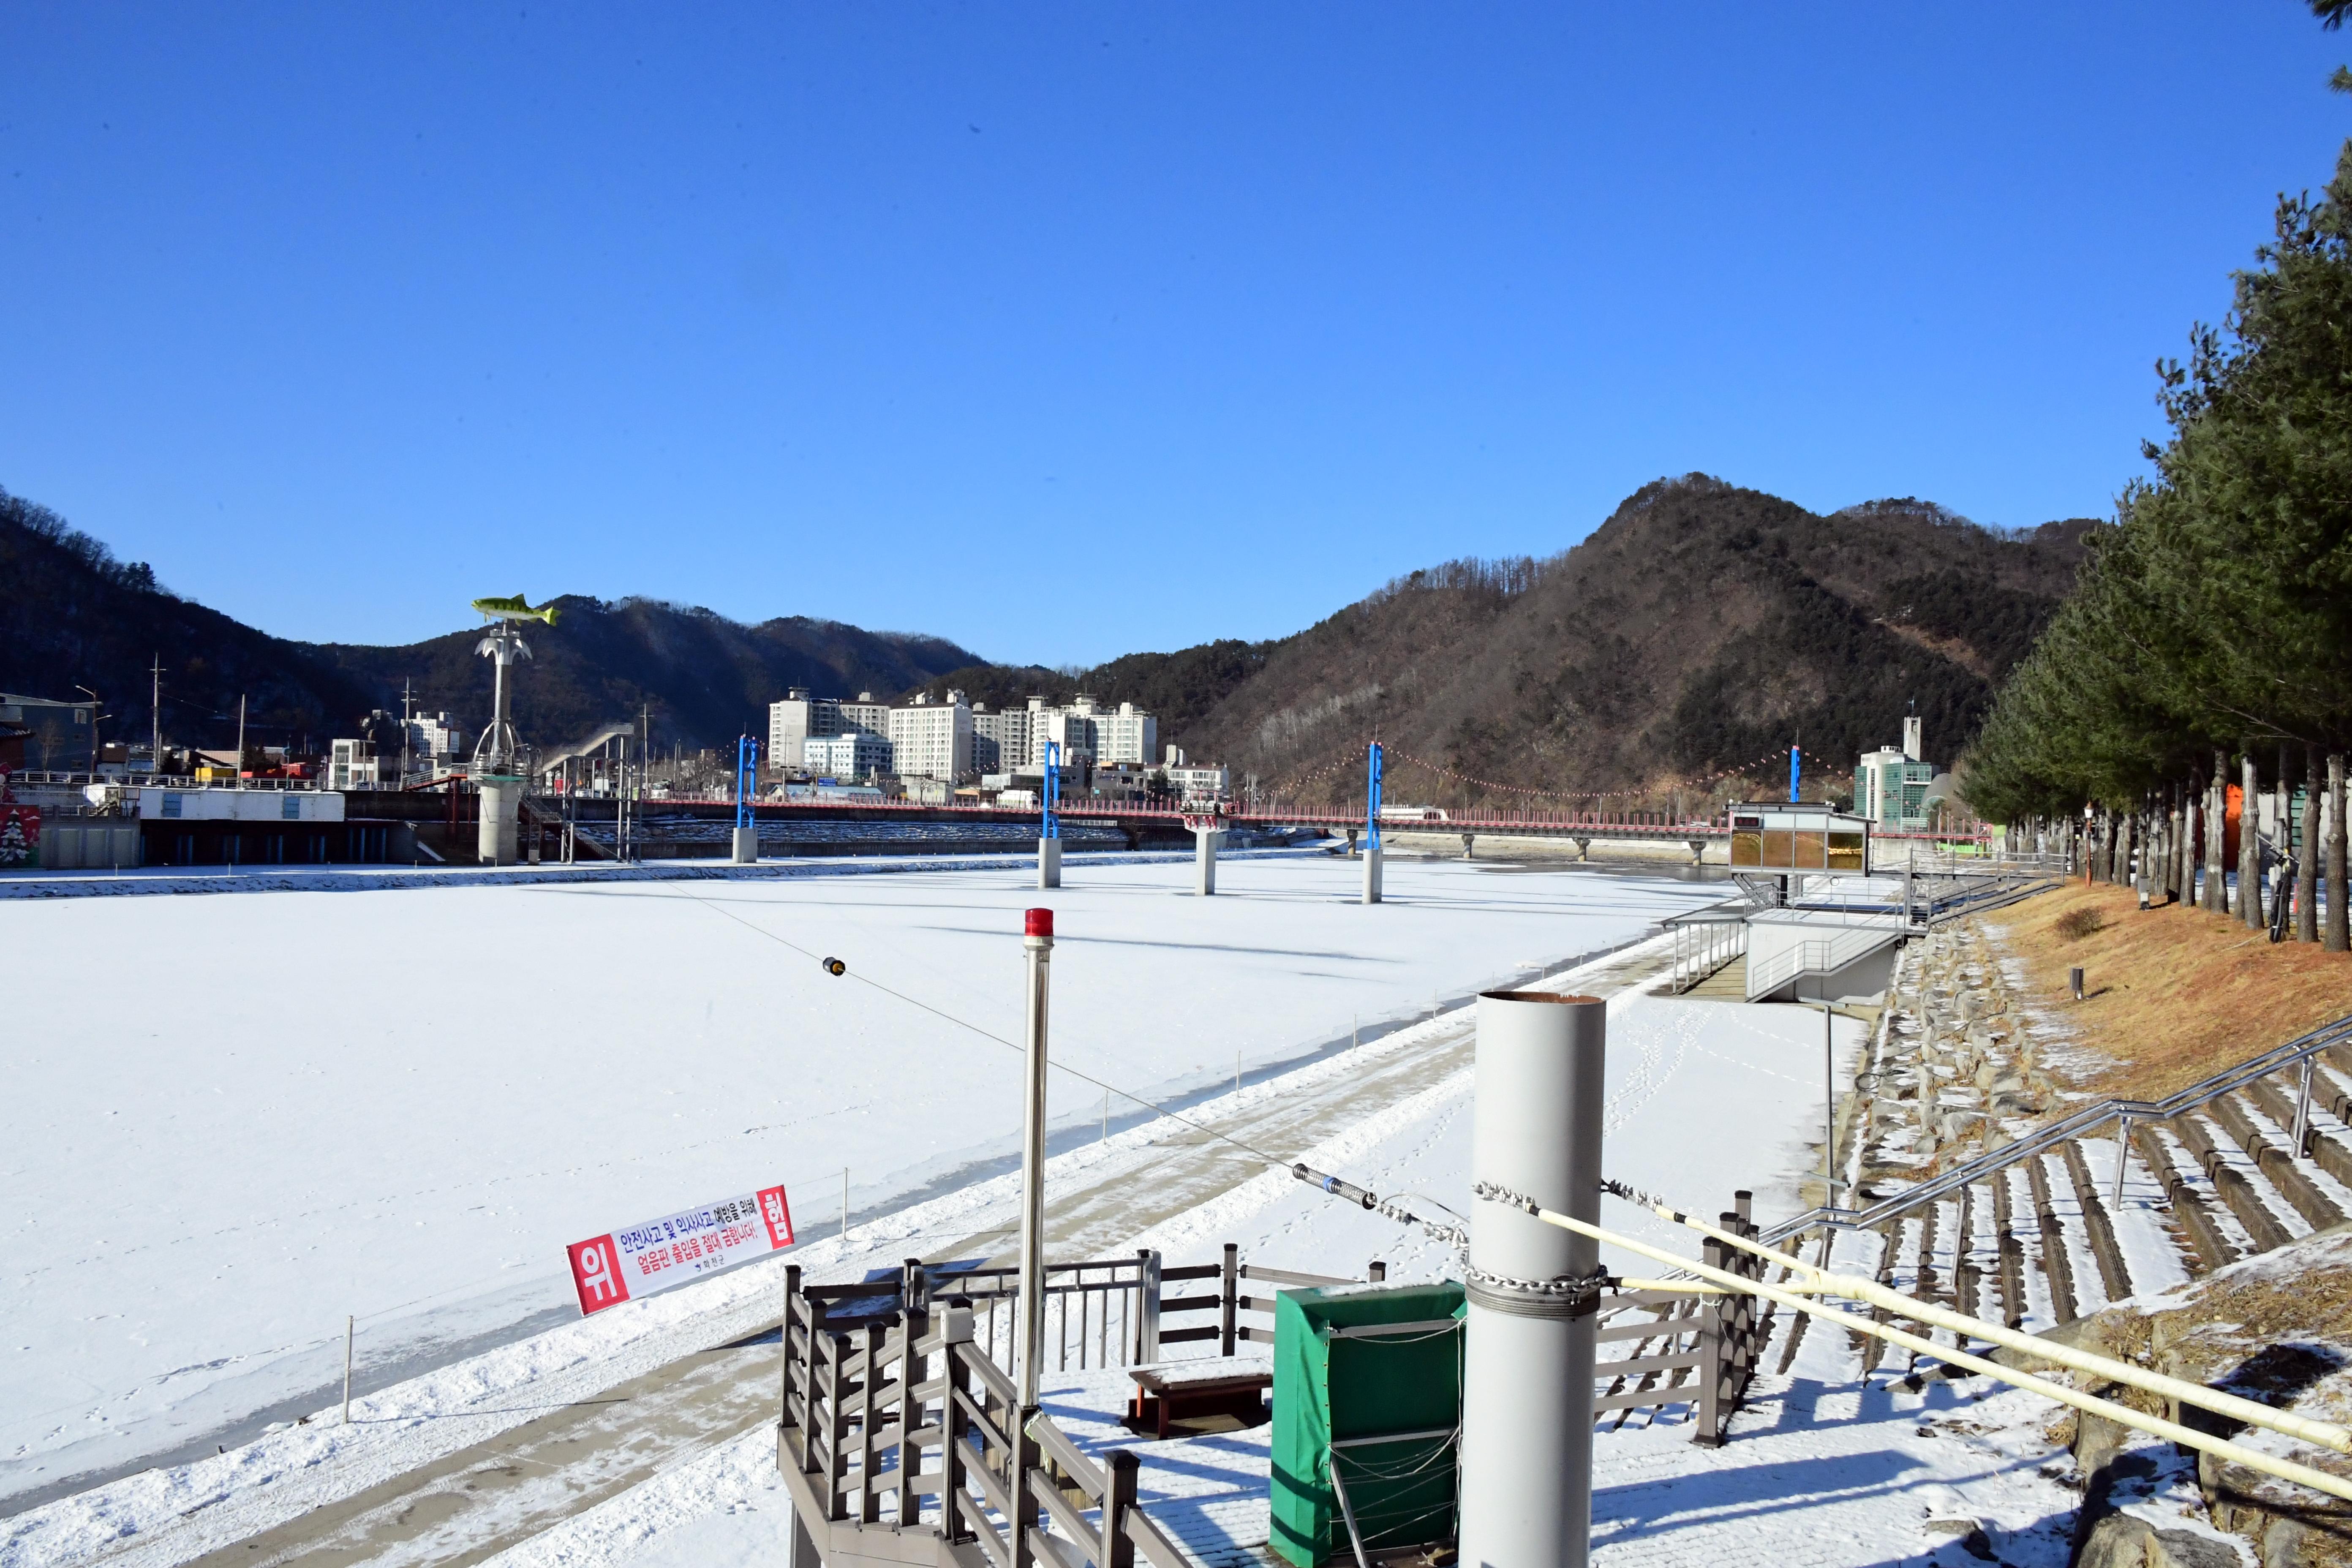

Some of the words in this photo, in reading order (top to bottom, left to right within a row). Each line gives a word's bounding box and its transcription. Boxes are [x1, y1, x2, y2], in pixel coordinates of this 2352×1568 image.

[621, 1226, 664, 1253] 안전사고
[663, 1220, 677, 1240] 및
[676, 1211, 714, 1235] 익사사고
[713, 1203, 740, 1224] 예방을
[740, 1198, 758, 1218] 위해
[764, 1192, 788, 1241] 험
[580, 1242, 618, 1301] 위
[638, 1247, 671, 1275] 얼음판
[672, 1238, 702, 1264] 출입을
[702, 1231, 723, 1253] 절대
[721, 1221, 758, 1247] 금합니다!
[703, 1255, 725, 1269] 화천군
